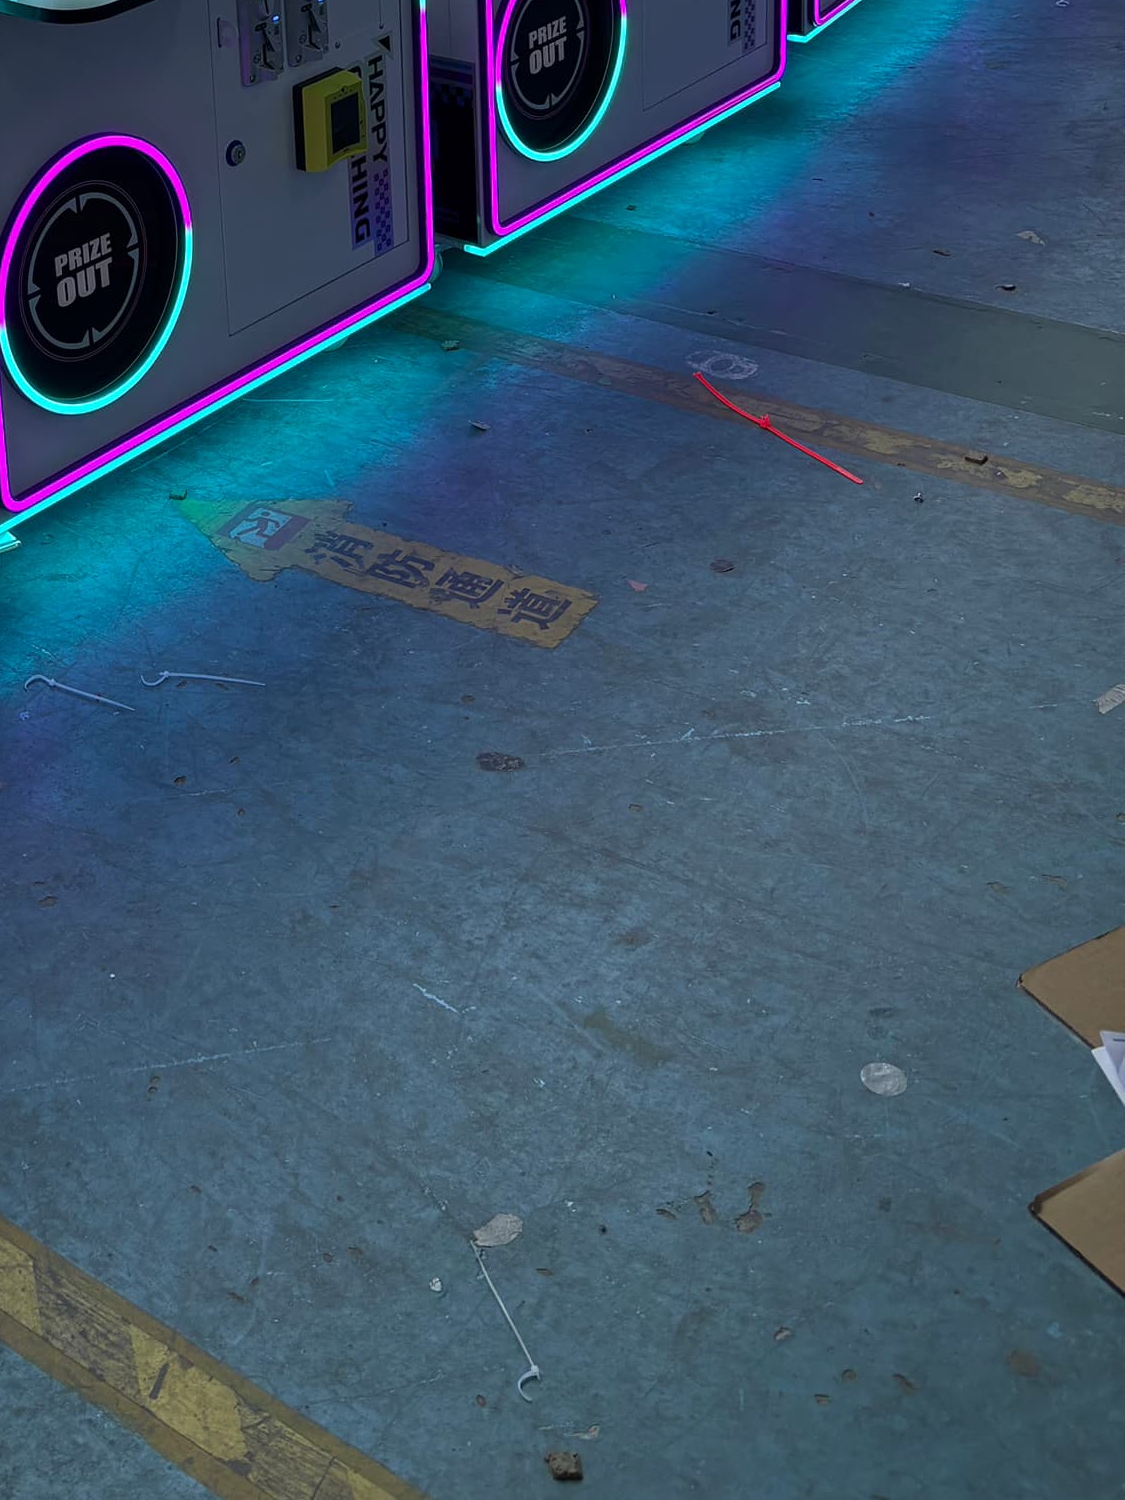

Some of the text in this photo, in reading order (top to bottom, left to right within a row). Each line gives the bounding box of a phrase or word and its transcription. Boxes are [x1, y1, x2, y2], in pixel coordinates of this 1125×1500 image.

[528, 15, 567, 50] PRIZE
[528, 36, 568, 75] OUT
[368, 55, 388, 163] HAPPY
[54, 231, 113, 278] PRIZE
[56, 256, 113, 308] OUT
[304, 529, 572, 630] 消防通道
